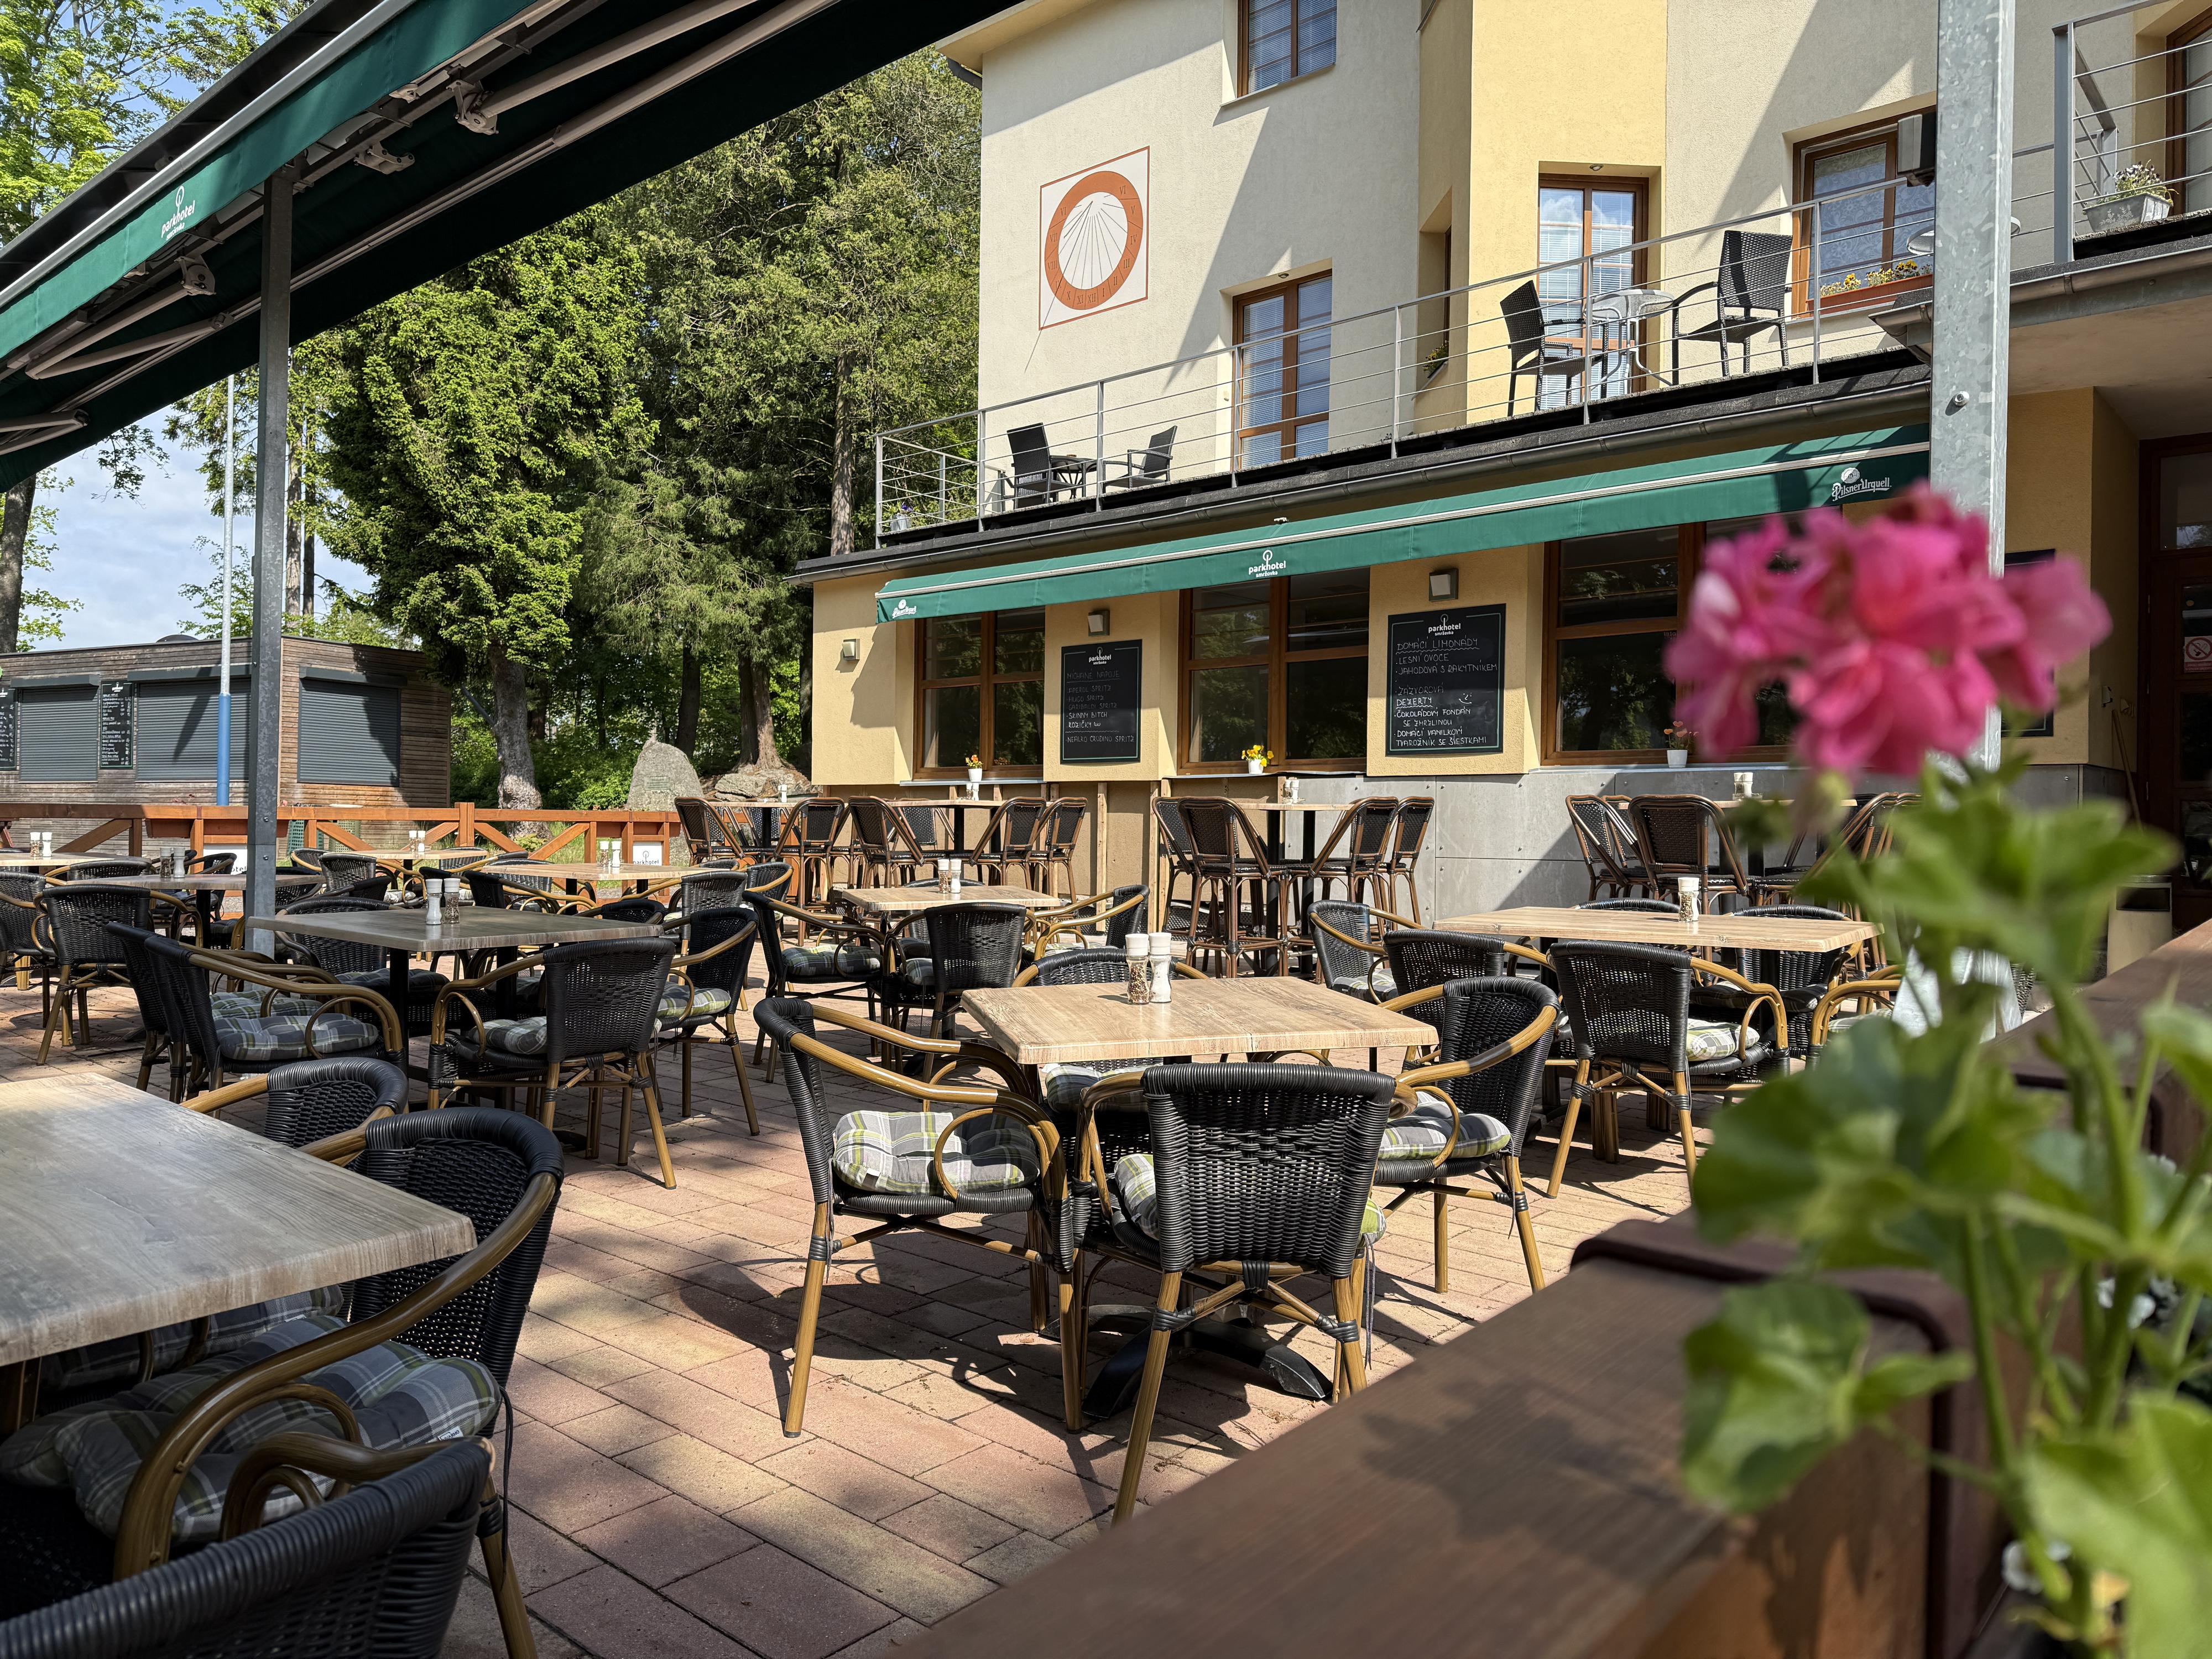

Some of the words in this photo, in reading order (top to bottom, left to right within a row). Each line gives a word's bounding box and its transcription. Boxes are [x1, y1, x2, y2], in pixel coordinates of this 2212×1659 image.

[1119, 185, 1126, 195] VI
[1060, 207, 1067, 216] VI
[1130, 206, 1135, 215] V
[161, 200, 195, 238] parkhotel
[1050, 233, 1058, 242] VII
[1130, 234, 1138, 245] IV
[1047, 260, 1057, 271] VIII
[1113, 276, 1118, 285] II
[1066, 291, 1071, 300] X
[1102, 288, 1105, 297] I
[1077, 295, 1084, 304] XI
[1087, 293, 1096, 304] XII
[1832, 482, 1862, 502] Pilsner
[1249, 560, 1286, 575] parkhotel
[1428, 622, 1461, 633] parkhotel
[1397, 637, 1428, 650] DOMÁCÍ
[1433, 634, 1478, 648] LIMONÁDY
[1088, 653, 1112, 662] parkhotel
[1399, 653, 1422, 665] LESNÍ
[1424, 653, 1449, 662] OVOCE
[1399, 663, 1438, 675] JAHODOVÁ
[1448, 660, 1498, 673] RAKYTNÍKEM
[1396, 697, 1432, 706] DEZERTY
[1396, 707, 1438, 717] ČOKOLÁDOVÝ
[1442, 706, 1471, 715] FONDÁN
[1397, 728, 1424, 737] DOMÁCÍ
[1427, 726, 1463, 735] VANILKOVÝ
[1449, 737, 1486, 746] ŠVESTKAMI
